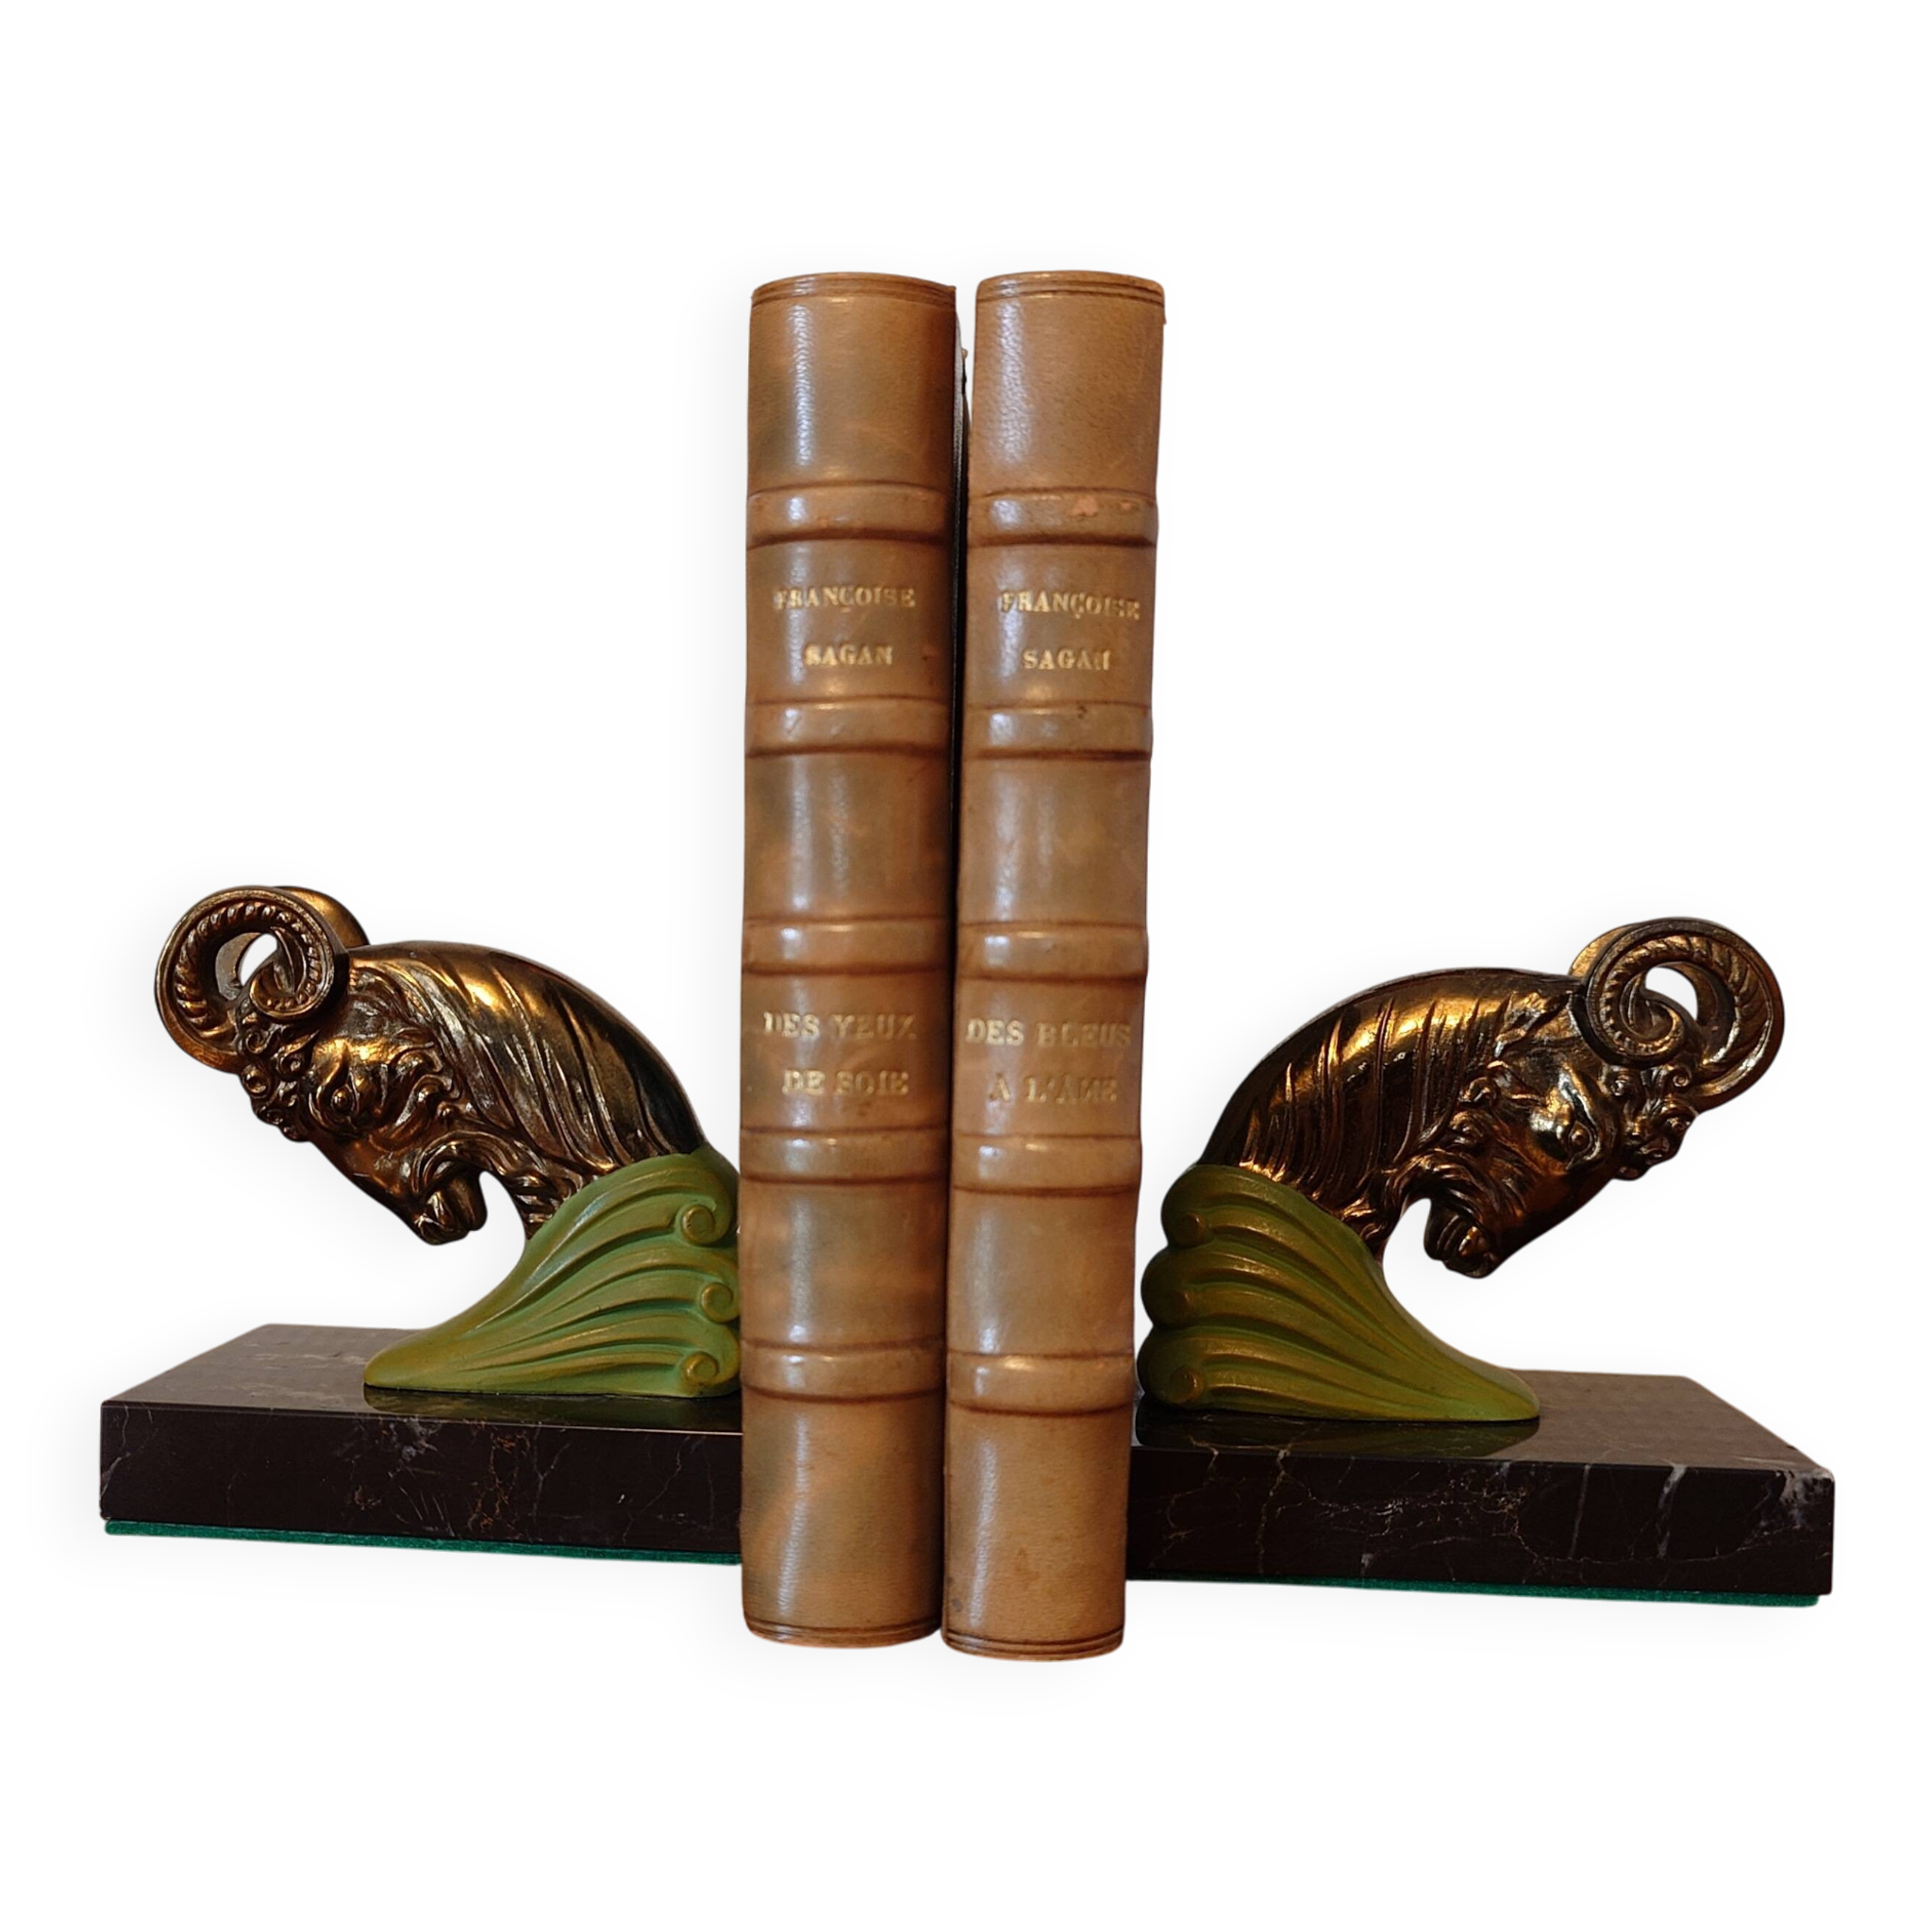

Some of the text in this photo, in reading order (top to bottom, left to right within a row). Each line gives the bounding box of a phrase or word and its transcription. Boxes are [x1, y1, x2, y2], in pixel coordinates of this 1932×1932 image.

[774, 587, 915, 612] FRANÇOISE
[1000, 591, 1141, 620] FRANÇOISE
[805, 644, 892, 666] SAGAN
[1023, 649, 1110, 671] SAGAN
[763, 1011, 916, 1041] DES YEUX
[965, 1019, 1131, 1047] DES BLEUS
[782, 1070, 908, 1095] DE SOIE
